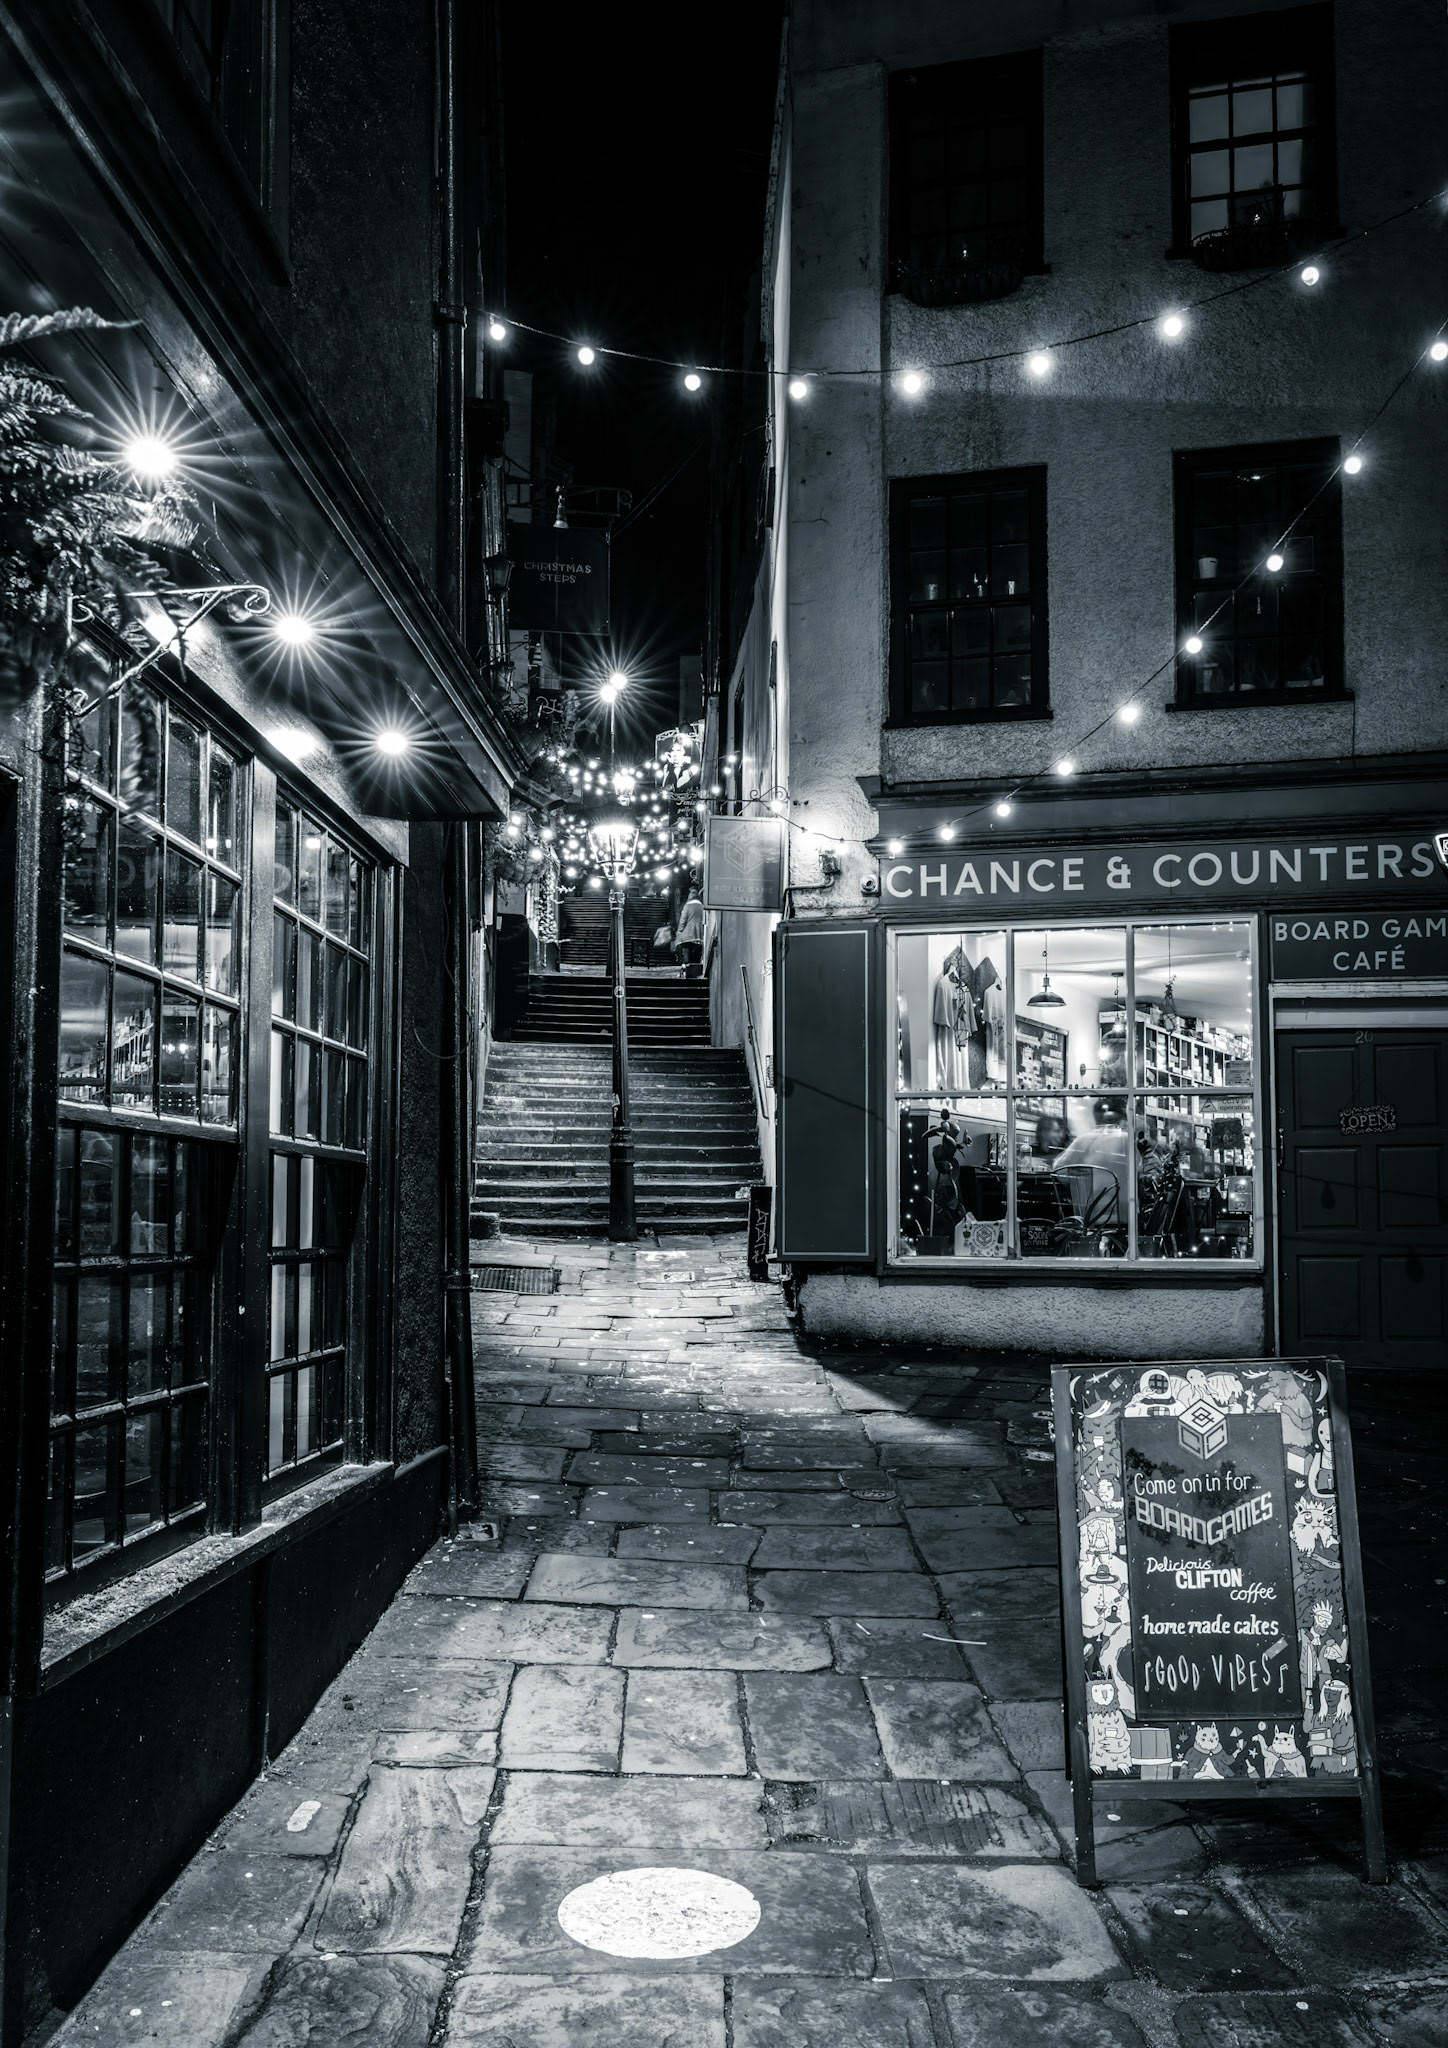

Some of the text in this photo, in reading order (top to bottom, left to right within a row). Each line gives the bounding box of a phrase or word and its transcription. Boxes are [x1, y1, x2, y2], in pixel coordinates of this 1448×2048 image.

[524, 561, 592, 574] CHRISTMAS
[539, 573, 576, 584] STEPS
[886, 842, 1435, 898] CHANCE & COUNTERS
[1274, 920, 1370, 942] BOARD
[1332, 944, 1406, 971] CAFÉ
[1355, 1030, 1374, 1044] 20
[1348, 1113, 1388, 1129] OPEN
[1134, 1472, 1177, 1496] Come
[1182, 1477, 1201, 1492] on
[1205, 1473, 1221, 1492] in
[1134, 1491, 1273, 1546] BOARDGAMES
[1175, 1568, 1243, 1589] CLIFTON
[1230, 1582, 1277, 1603] coffee
[1233, 1613, 1279, 1636] cakes
[1155, 1652, 1271, 1692] GOOD VIBES
